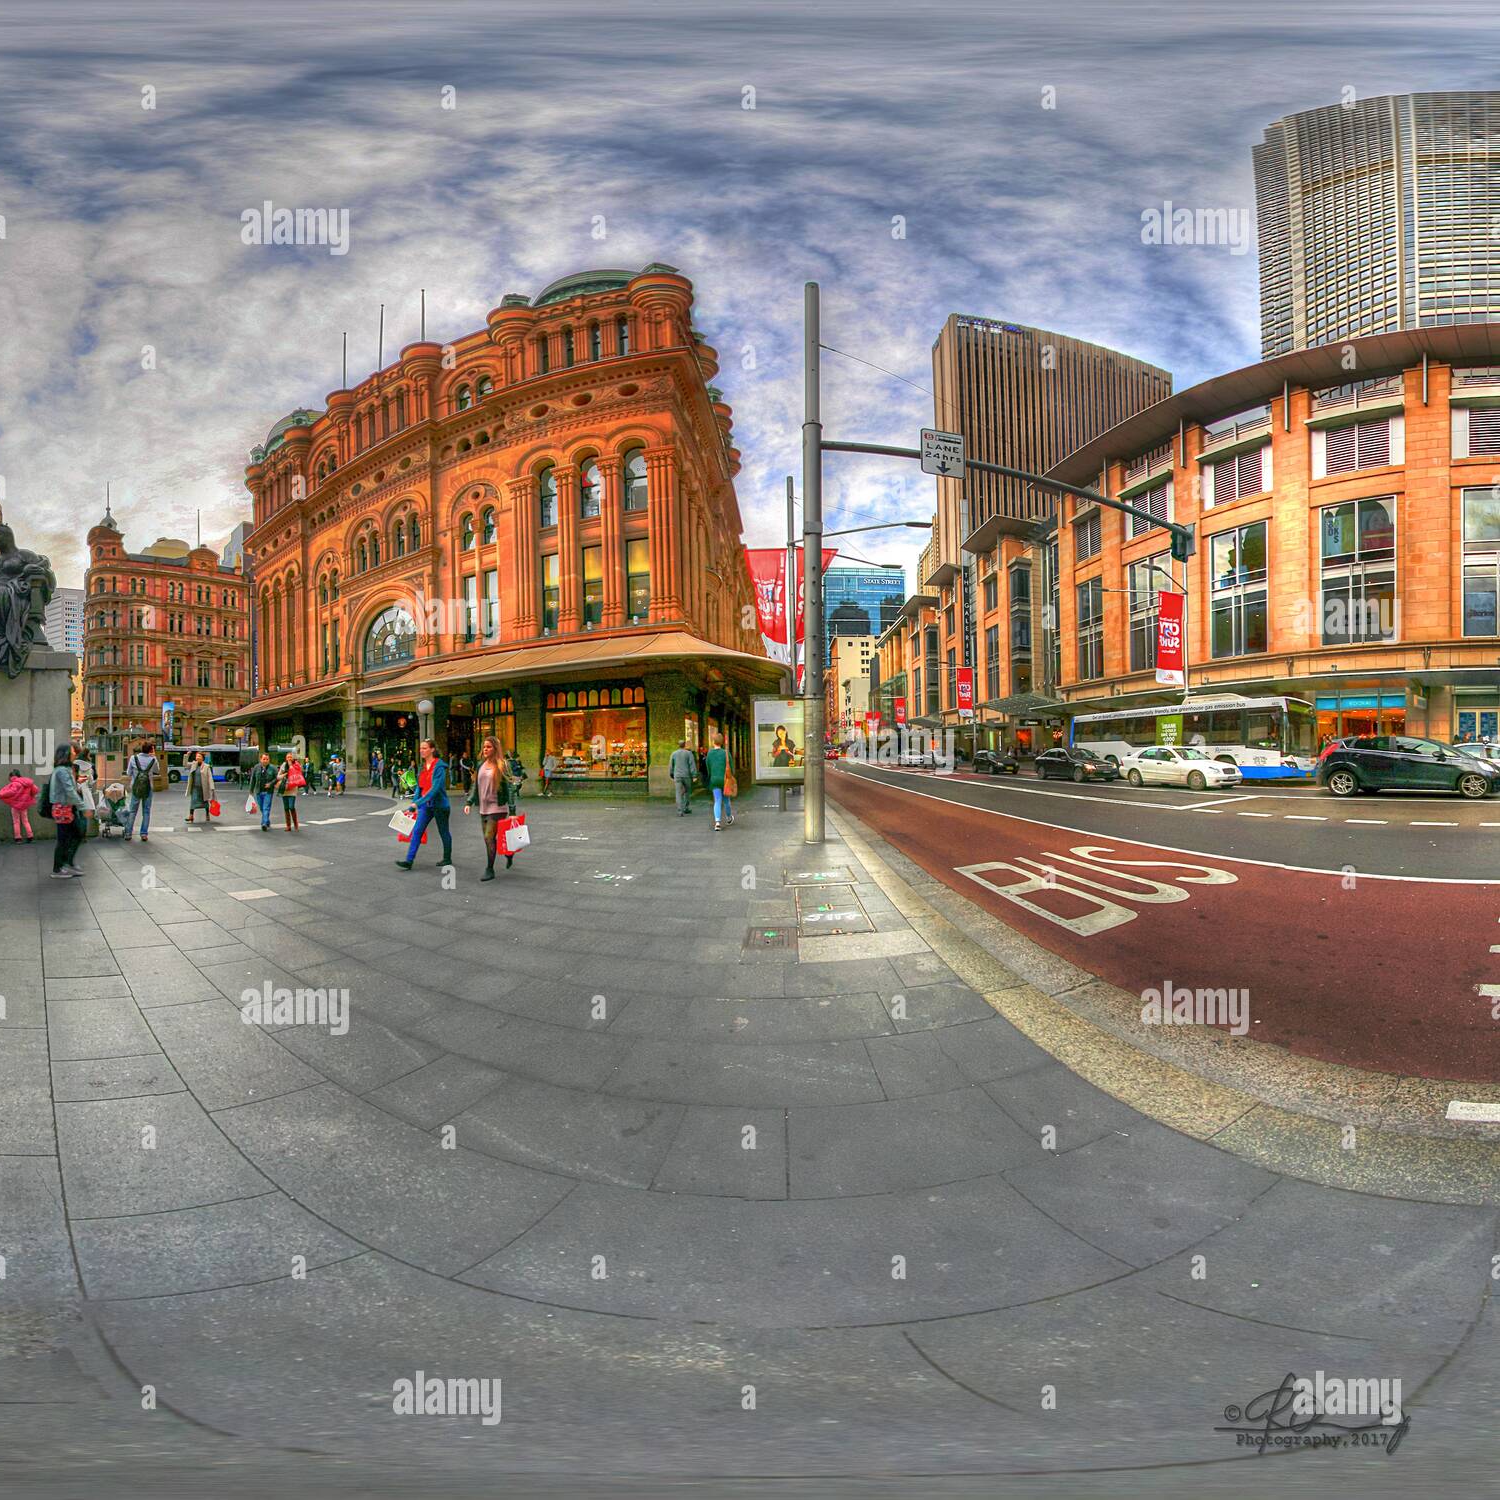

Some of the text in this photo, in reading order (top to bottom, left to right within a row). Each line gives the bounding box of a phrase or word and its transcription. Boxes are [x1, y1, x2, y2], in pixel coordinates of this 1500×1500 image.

[927, 443, 960, 454] LANE
[925, 451, 962, 463] 24hrs
[953, 845, 1239, 937] BUS
